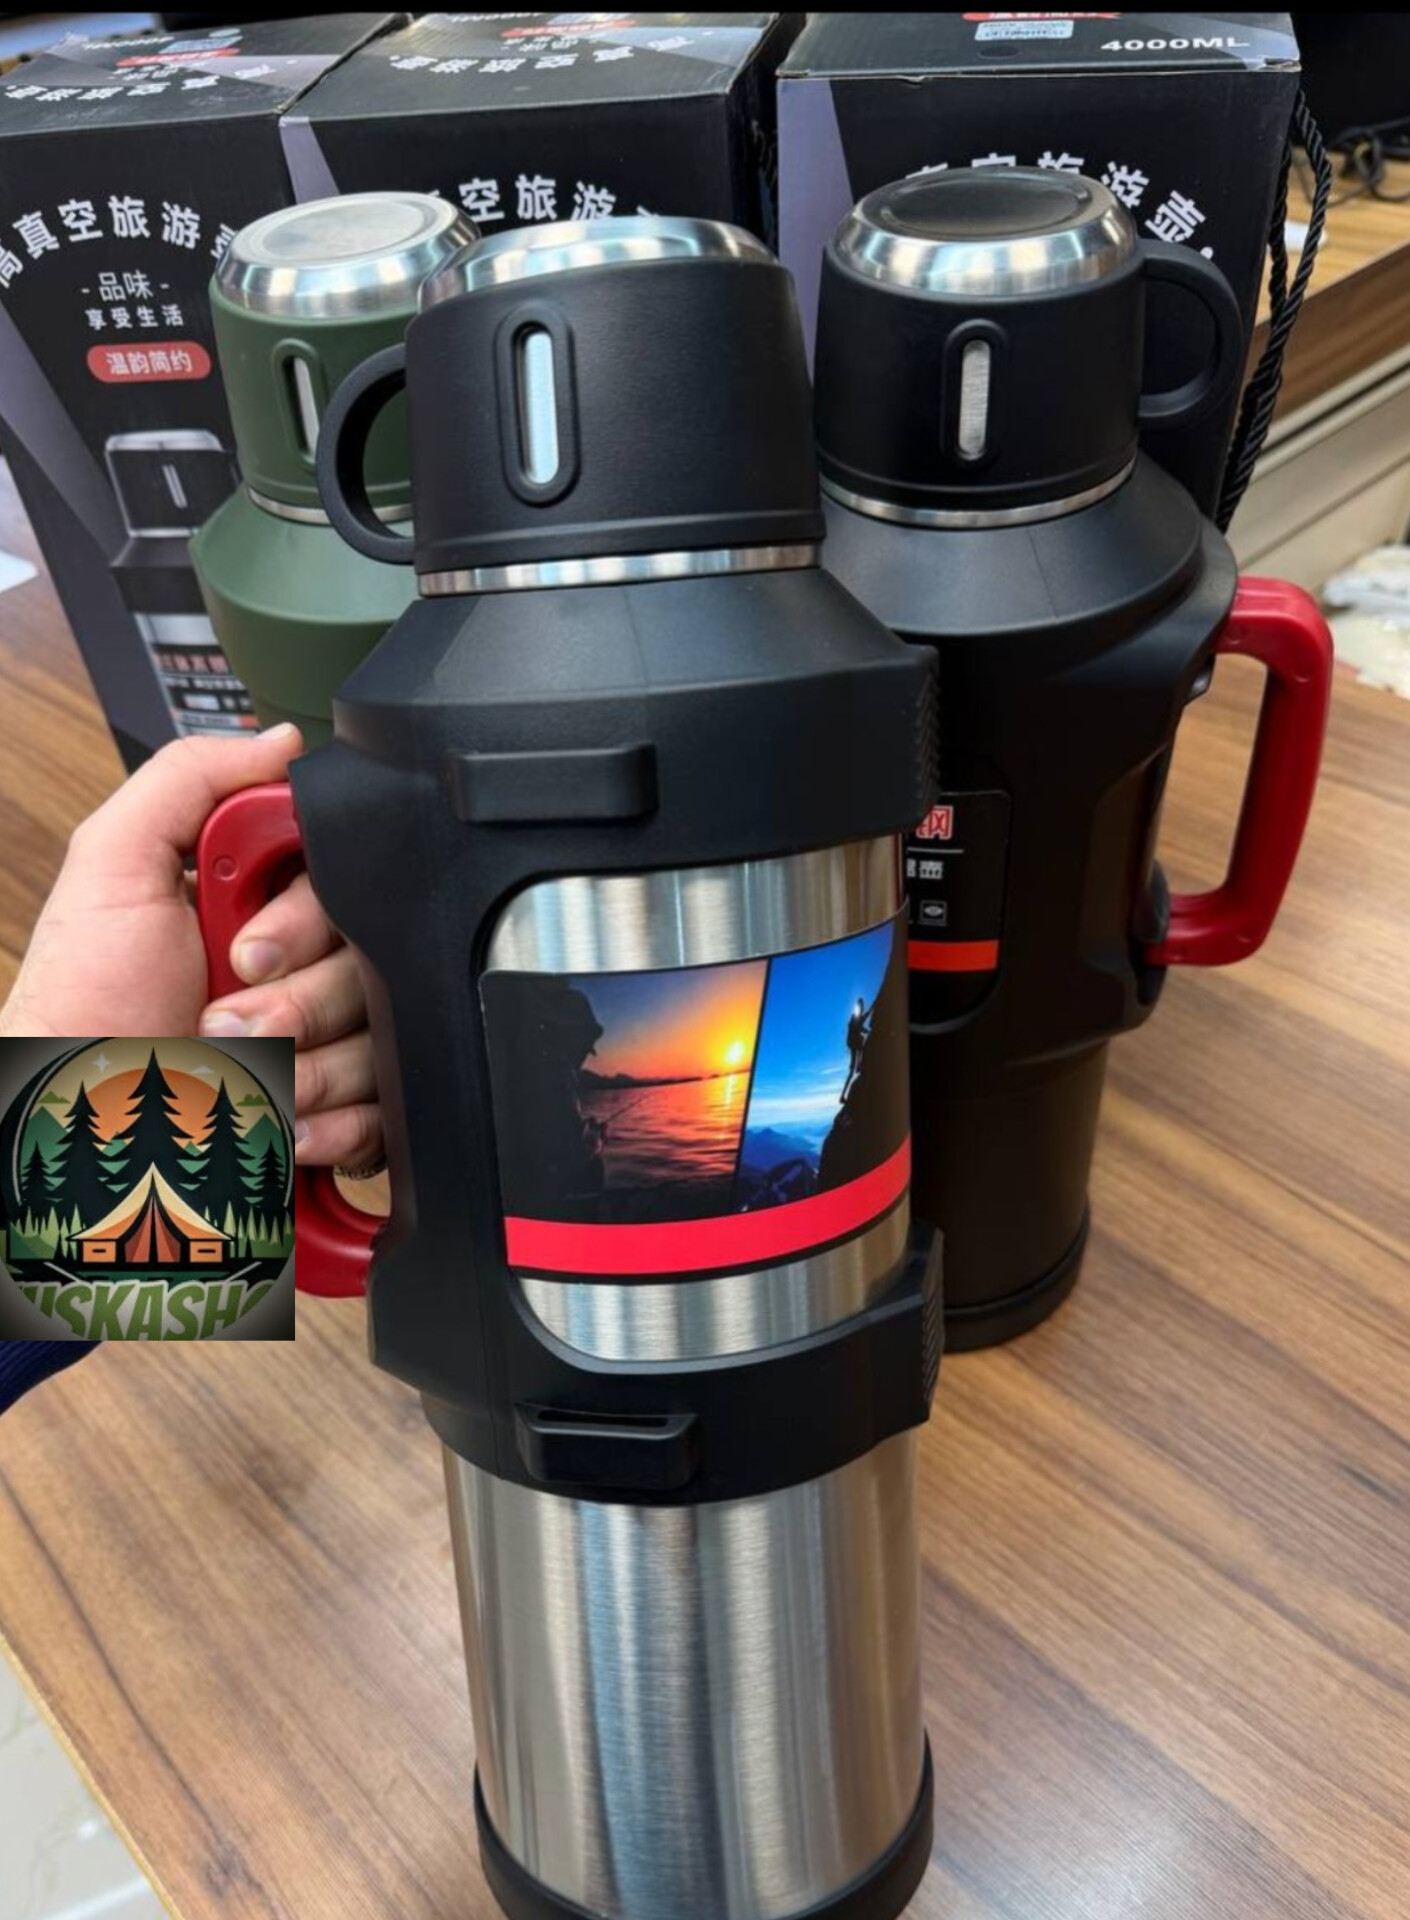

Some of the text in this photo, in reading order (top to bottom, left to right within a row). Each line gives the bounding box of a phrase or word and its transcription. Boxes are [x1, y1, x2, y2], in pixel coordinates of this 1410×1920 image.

[1101, 37, 1250, 52] 4000ML
[84, 303, 185, 331] 享受生活
